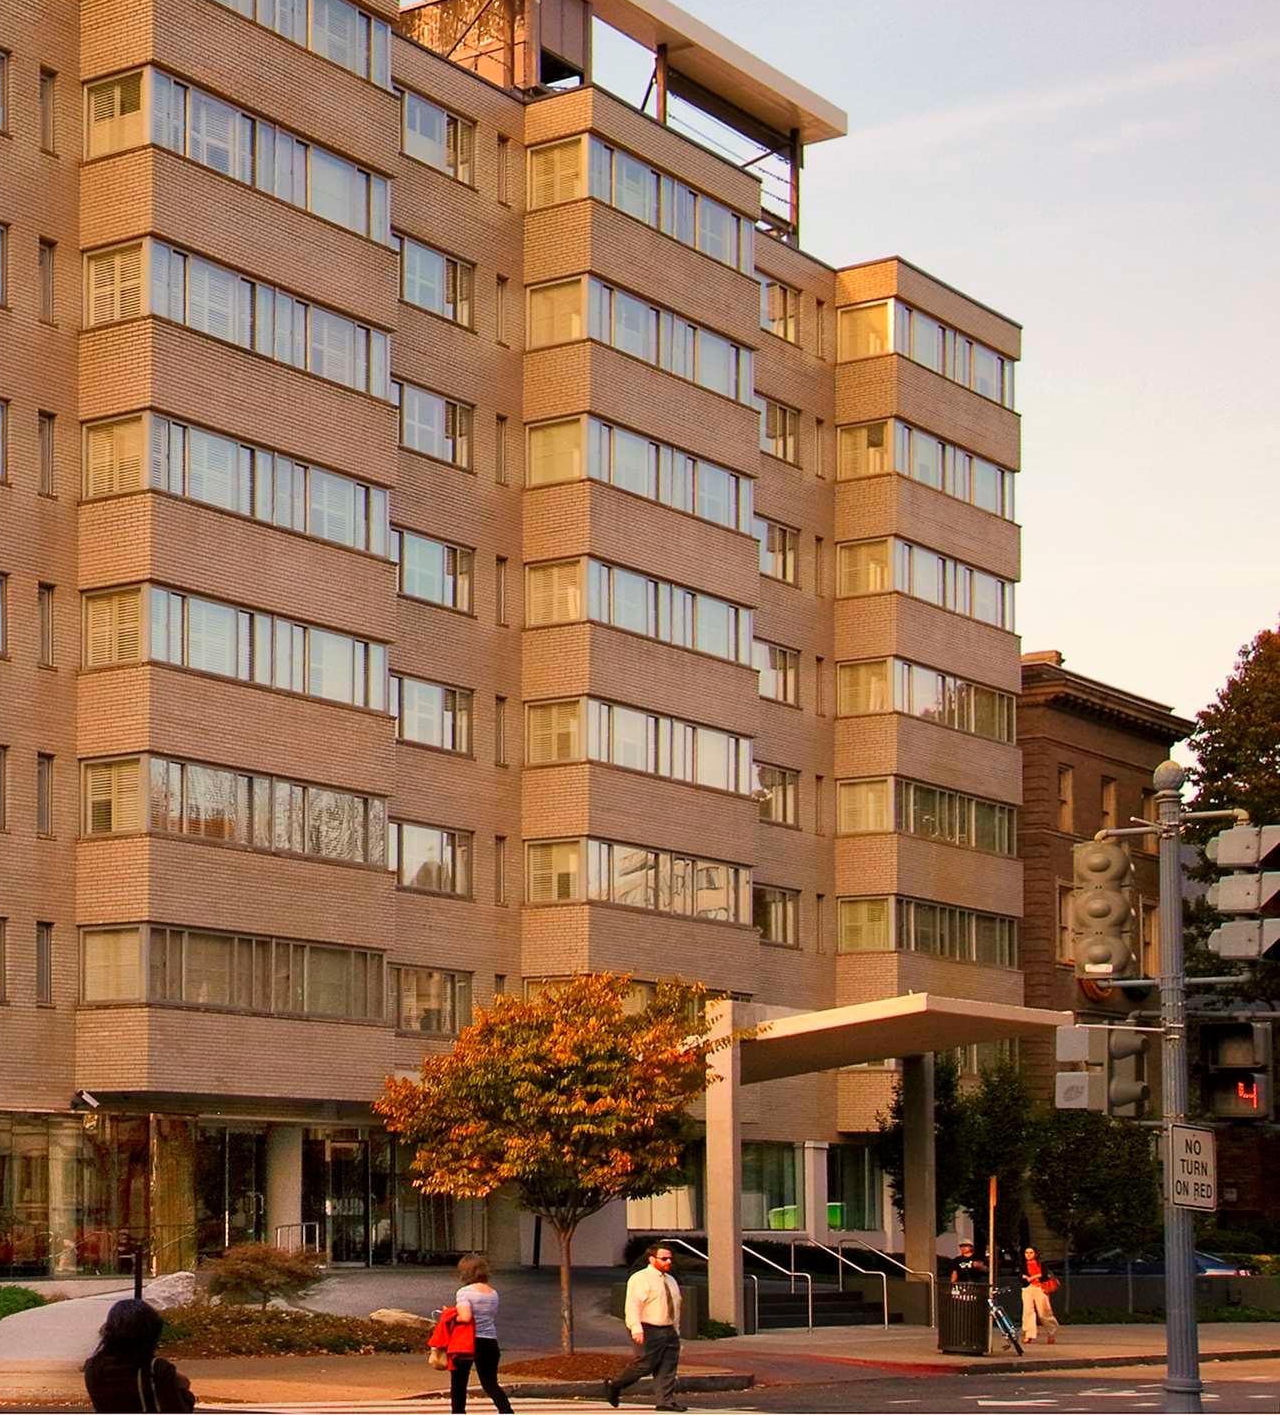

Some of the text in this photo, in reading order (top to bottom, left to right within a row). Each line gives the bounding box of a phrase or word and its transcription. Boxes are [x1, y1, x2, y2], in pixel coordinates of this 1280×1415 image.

[1185, 1139, 1202, 1156] NO
[1180, 1158, 1208, 1177] TURN
[1175, 1180, 1213, 1199] ON RED
